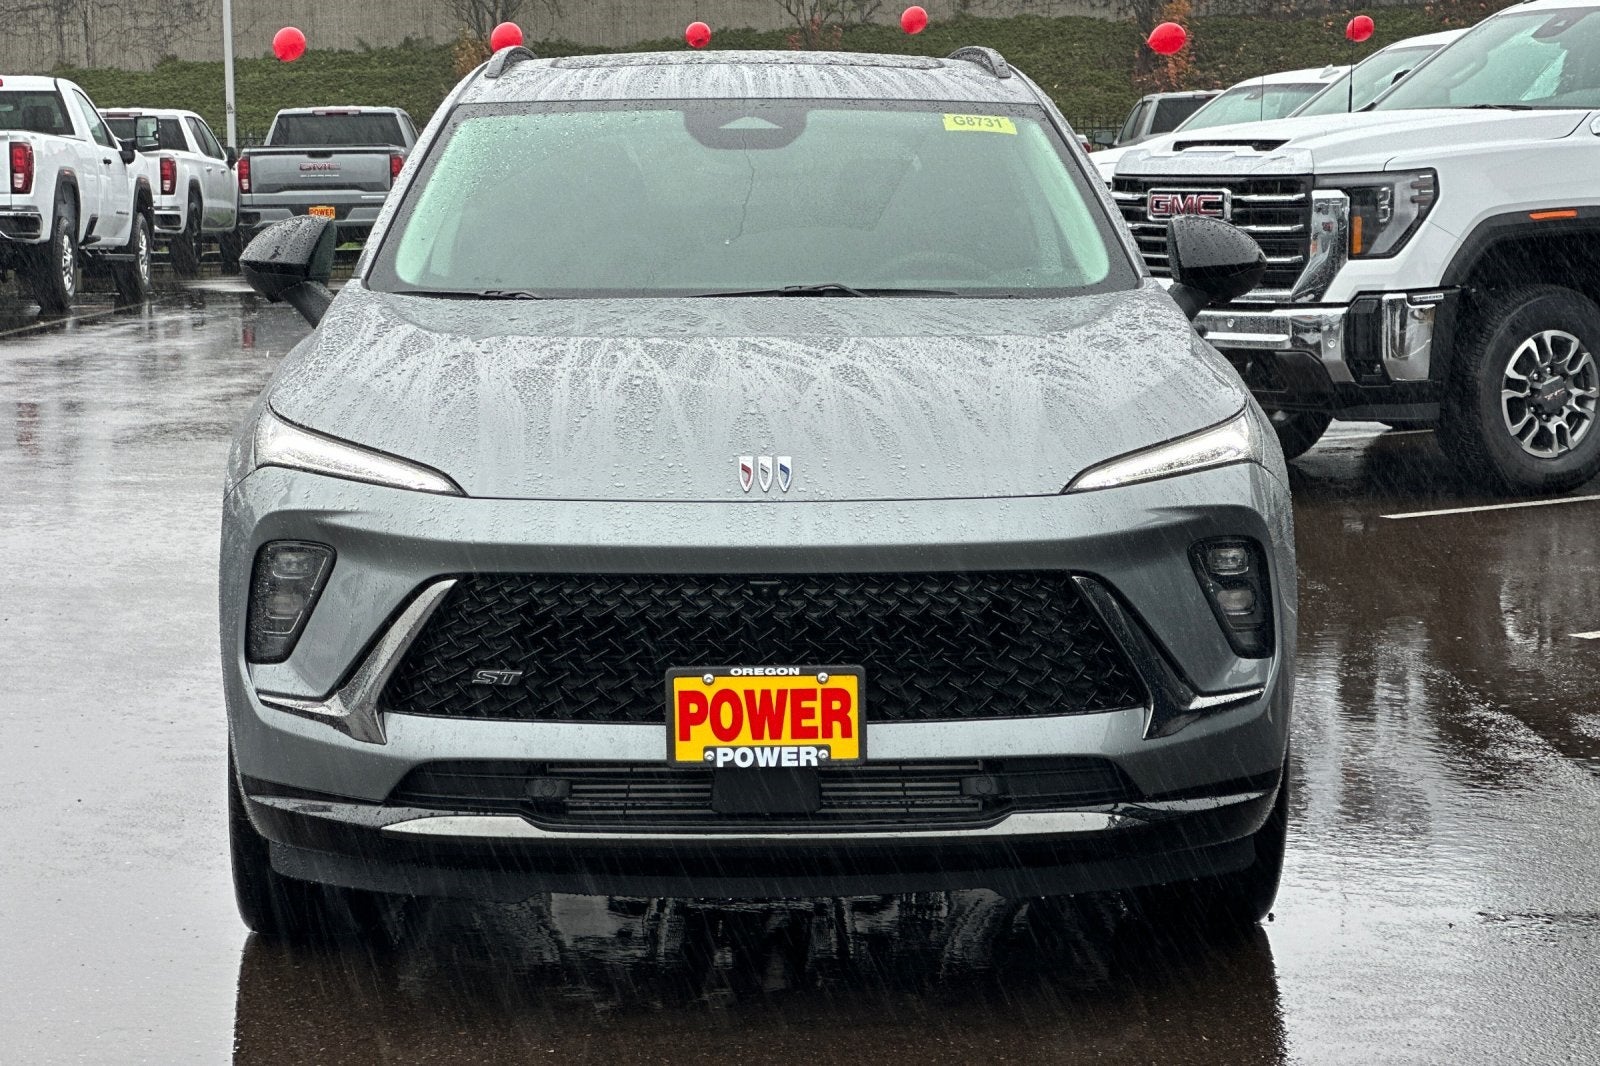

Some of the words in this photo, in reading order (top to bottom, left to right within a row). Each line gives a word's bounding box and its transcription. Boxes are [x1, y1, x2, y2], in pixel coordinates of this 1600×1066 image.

[953, 115, 1004, 128] G8731
[309, 208, 335, 216] POWER
[1151, 194, 1223, 216] GMC
[471, 669, 523, 686] ST
[729, 667, 800, 676] OREGON
[678, 688, 853, 742] POWER
[716, 746, 818, 768] POWER
